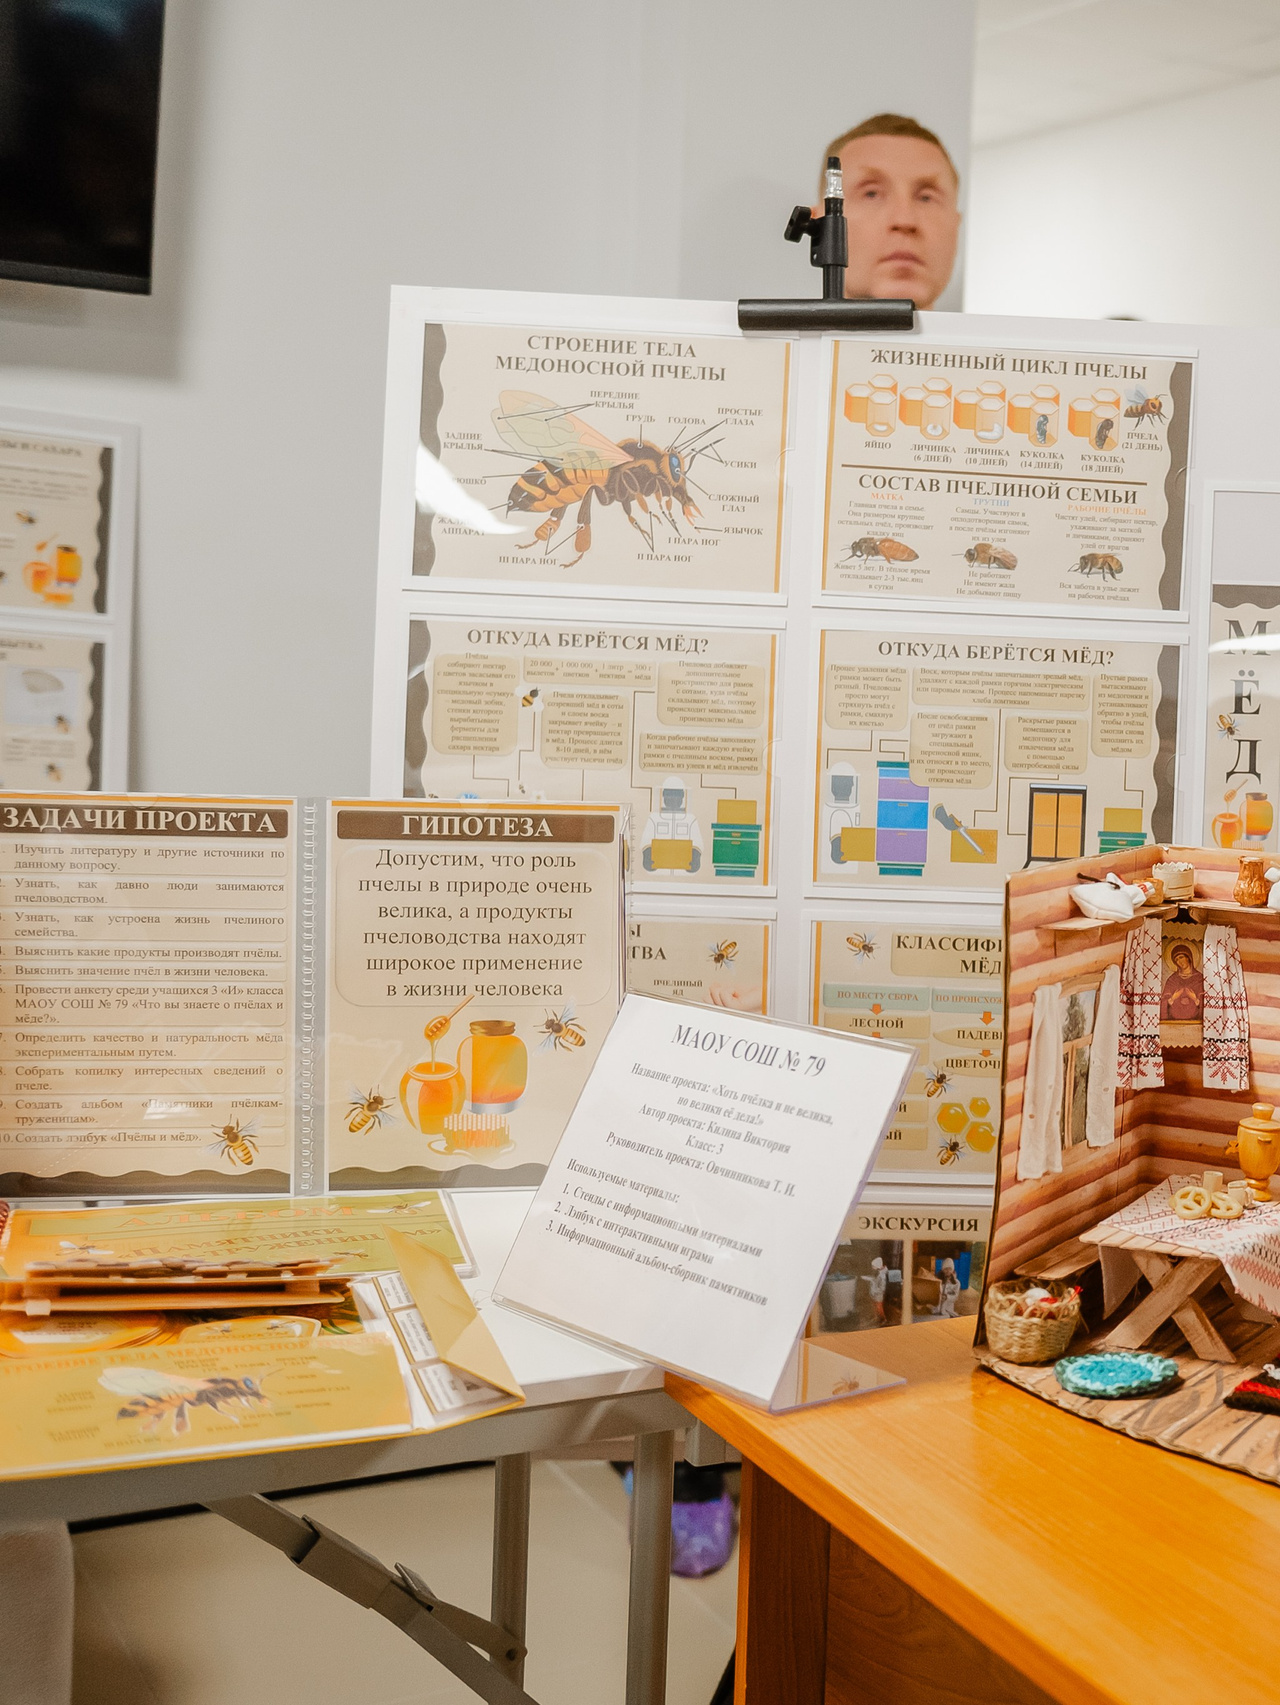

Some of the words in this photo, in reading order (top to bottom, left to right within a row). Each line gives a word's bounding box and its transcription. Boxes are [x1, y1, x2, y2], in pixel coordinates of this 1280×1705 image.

[527, 334, 637, 356] СТРОЕНИЕ
[643, 341, 696, 359] ТЕЛА
[495, 354, 645, 378] МЕДОНОСНОЙ
[652, 364, 726, 382] ПЧЕЛЫ
[871, 348, 1005, 371] ЖИЗНЕННЫЙ
[1012, 357, 1067, 377] ЦИКЛ
[1074, 362, 1147, 381] ПЧЕЛЫ
[590, 391, 640, 400] ПЕРЕДНИЕ
[595, 401, 634, 409] КРЫЛЬЯ
[717, 408, 763, 416] ПРОСТЫЕ
[626, 414, 655, 422] ГРУДЬ
[668, 417, 706, 425] ГОЛОВА
[725, 418, 754, 426] ГЛАЗА
[445, 432, 482, 440] ЗАДНИЕ
[1127, 432, 1158, 441] ПЧЕЛА
[443, 442, 483, 451] КРЫЛЬЯ
[864, 441, 891, 450] ЯЙЦО
[910, 444, 956, 453] ЛИЧИНКА
[1122, 442, 1133, 450] (21
[1135, 443, 1163, 452] ДЕНЬ)
[964, 447, 1010, 456] ЛИЧИНКА
[1020, 451, 1064, 460] КУКОЛКА
[723, 460, 757, 469] УСИКИ
[923, 455, 952, 464] ДНЕЙ)
[979, 458, 1007, 467] ДНЕЙ)
[1081, 454, 1125, 464] КУКОЛКА
[1034, 461, 1062, 470] ДНЕЙ)
[1095, 465, 1123, 474] ДНЕЙ)
[859, 474, 940, 492] СОСТАВ
[946, 479, 1060, 500] ПЧЕЛИНОЙ
[1067, 487, 1137, 504] СЕМЬИ
[708, 493, 759, 503] СЛОЖНЫЙ
[1067, 504, 1110, 513] РАБОЧИЕ
[1113, 506, 1146, 515] ПЧЁЛЫ
[723, 527, 763, 535] ЯЗЫЧОК
[512, 556, 536, 564] ПАРА
[467, 628, 551, 649] ОТКУДА
[558, 631, 649, 651] БЕРЁТСЯ
[655, 634, 709, 654] МЁД?
[878, 640, 960, 660] ОТКУДА
[967, 643, 1055, 664] БЕРЁТСЯ
[1061, 647, 1114, 666] МЁД?
[1224, 619, 1271, 784] МЁД
[3, 806, 126, 832] ЗАДАЧИ
[134, 810, 277, 833] ПРОЕКТА
[402, 815, 553, 837] ГИПОТЕЗА
[14, 844, 64, 856] Изучить
[70, 846, 137, 858] литературу
[157, 848, 198, 859] другие
[203, 849, 264, 858] источники
[270, 850, 284, 858] по
[375, 848, 485, 870] Допустим,
[491, 854, 524, 867] что
[531, 855, 576, 872] роль
[14, 860, 66, 870] данному
[70, 861, 120, 872] вопросу.
[14, 878, 60, 890] Узнать,
[78, 880, 98, 889] как
[114, 881, 150, 891] давно
[167, 882, 198, 892] люди
[216, 882, 284, 891] занимаются
[358, 879, 422, 892] пчелы
[429, 880, 439, 891] в
[446, 881, 529, 896] природе
[536, 881, 592, 893] очень
[14, 894, 108, 904] пчеловодством.
[378, 905, 453, 921] велика,
[460, 906, 469, 918] а
[476, 906, 572, 923] продукты
[363, 931, 501, 946] пчеловодства
[507, 932, 586, 946] находят
[366, 958, 456, 975] широкое
[462, 958, 583, 975] применение
[654, 979, 703, 987] ПЧЕЛИНЫЙ
[387, 985, 396, 996] в
[403, 985, 467, 997] жизни
[474, 984, 563, 997] человека
[854, 991, 886, 1000] МЕСТУ
[889, 993, 918, 1001] СБОРА
[849, 1017, 904, 1028] ЛЕСНОЙ
[671, 1024, 733, 1055] МАОУ
[731, 1038, 779, 1067] СОШ
[778, 1049, 800, 1072] №
[803, 1055, 825, 1078] 79
[631, 1063, 671, 1083] Название
[671, 1073, 711, 1095] проекта:
[712, 1082, 739, 1101] «Хоть
[740, 1092, 773, 1111] пчёлка
[775, 1099, 783, 1110] и
[784, 1100, 795, 1114] не
[796, 1105, 834, 1126] велика,
[639, 1103, 666, 1123] Автор
[667, 1112, 705, 1133] проекта:
[706, 1120, 741, 1141] Килина
[743, 1131, 791, 1155] Виктория
[685, 1135, 715, 1155] Класс:
[717, 1143, 724, 1155] 3
[567, 1158, 627, 1190] Используемые
[629, 1178, 680, 1204] материалы:
[116, 1205, 354, 1228] АЛЬБОМ
[858, 1215, 979, 1233] ЭКСКУРСИЯ
